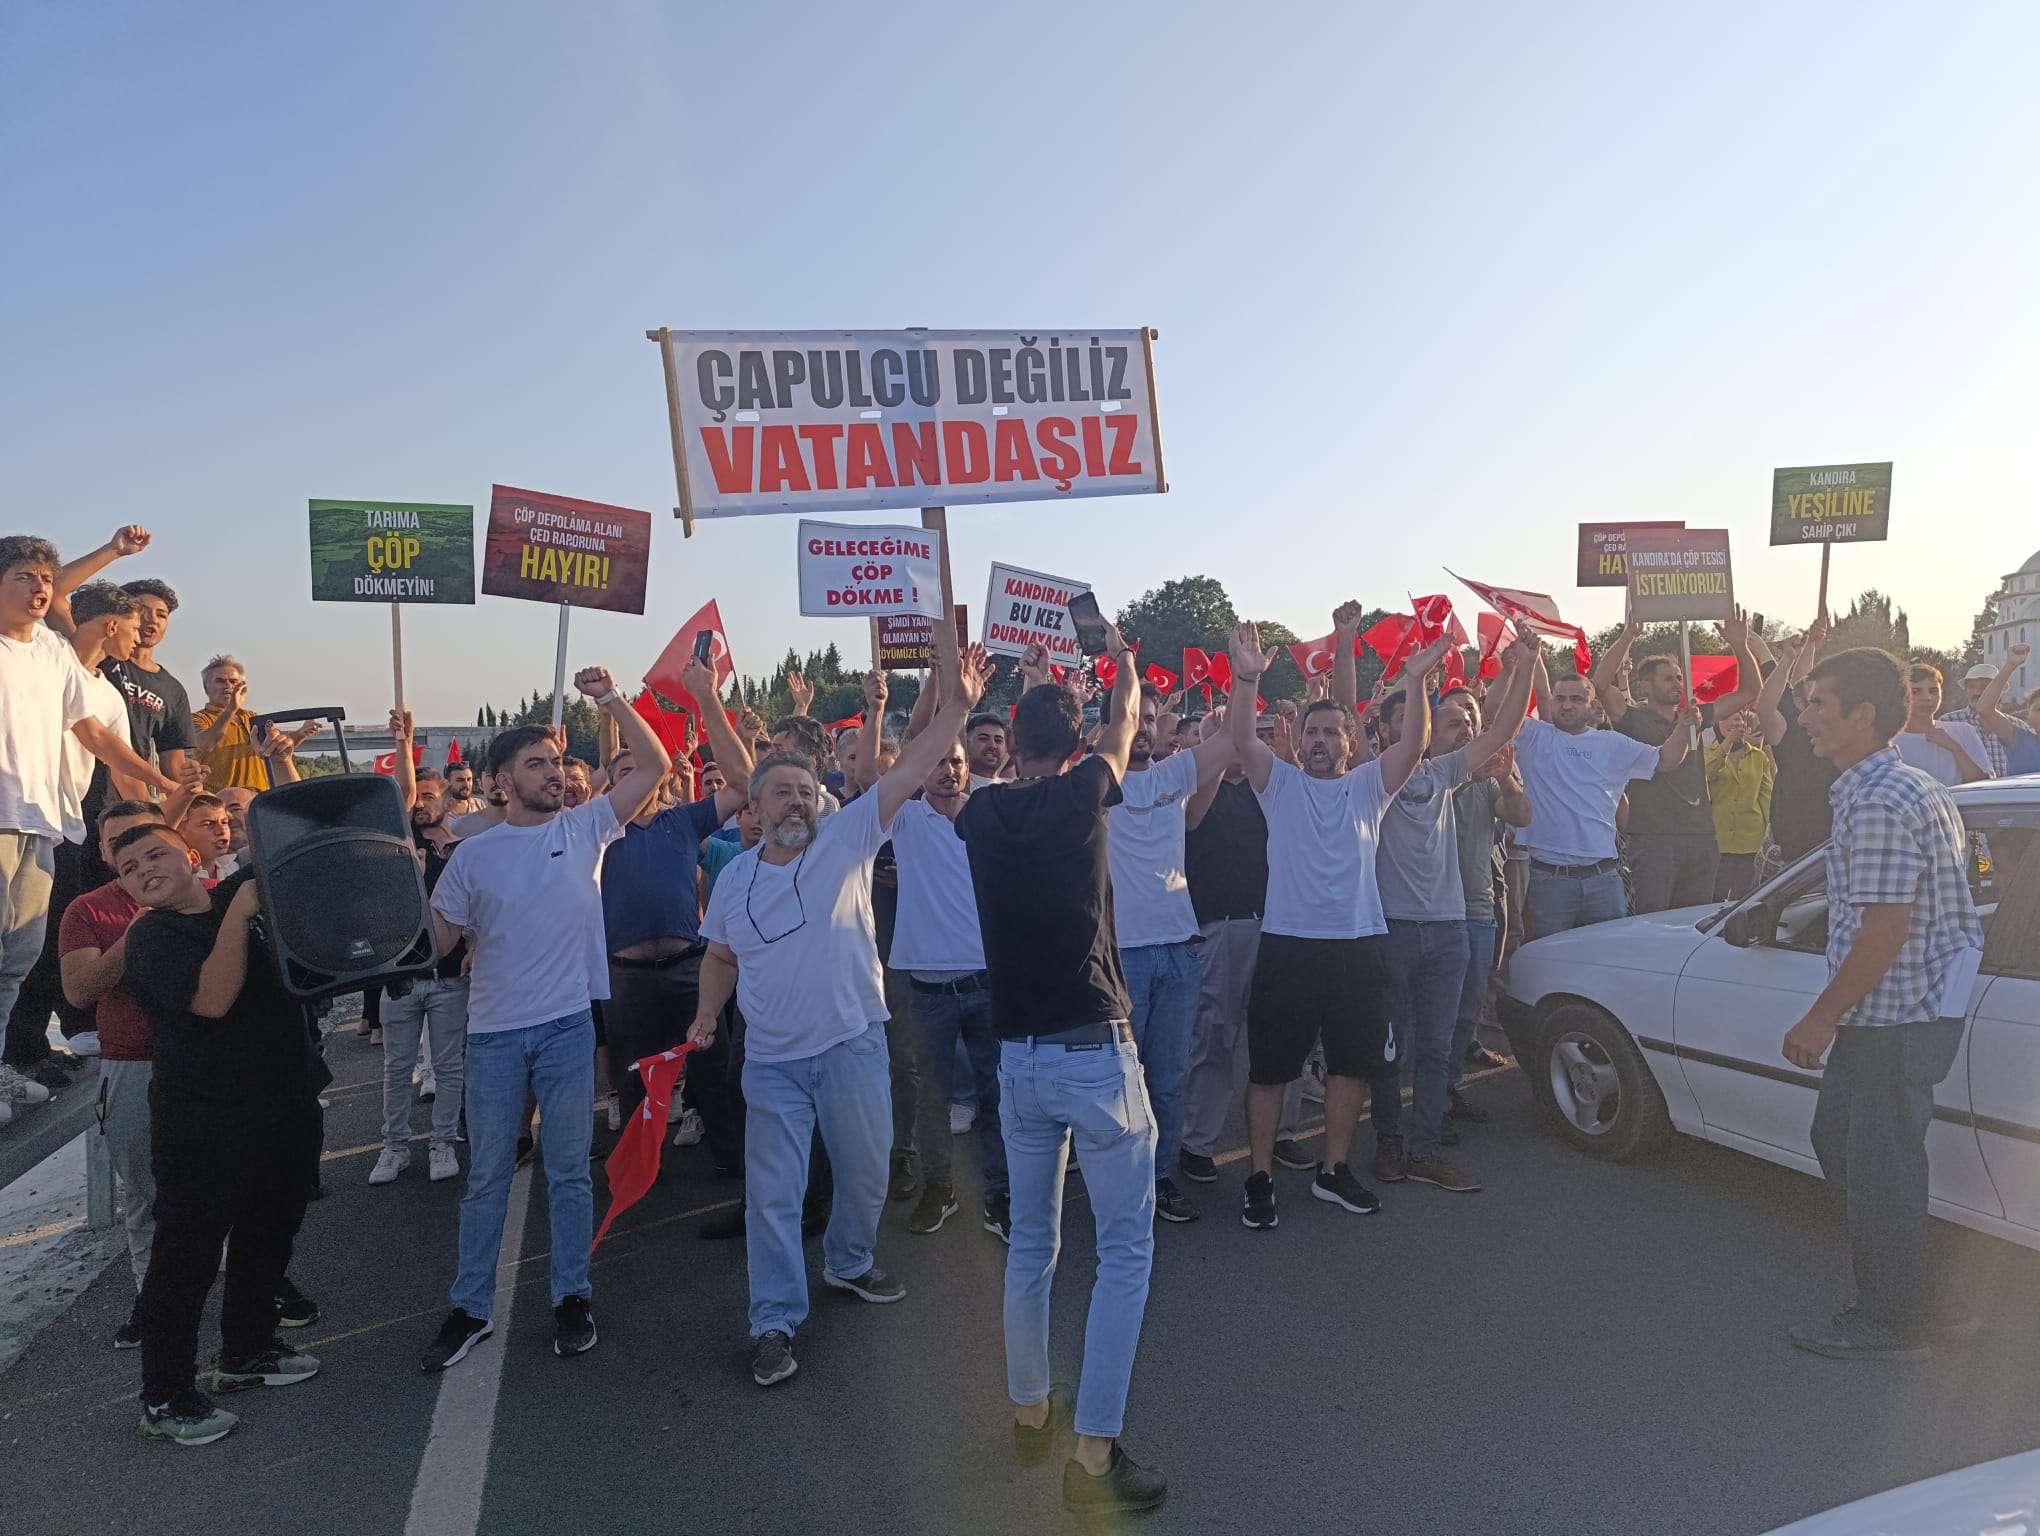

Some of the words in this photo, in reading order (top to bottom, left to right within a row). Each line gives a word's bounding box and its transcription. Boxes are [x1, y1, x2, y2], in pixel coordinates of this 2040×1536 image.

[697, 348, 941, 422] ÇAPULCU
[953, 336, 1131, 405] DEĞİLİZ
[700, 414, 1142, 494] VATANDAŞIZ
[1810, 470, 1856, 486] KANDIRA
[1788, 486, 1876, 522] YEŞİLİNE
[365, 509, 420, 528] TARIMA
[514, 506, 536, 524] ÇÖP
[537, 512, 592, 534] DEPOLAMA
[593, 522, 623, 538] ALANI
[530, 527, 550, 544] ÇED
[552, 531, 605, 552] RAPORUNA
[1593, 532, 1607, 543] ÇÖP
[1802, 522, 1833, 539] SAHİP
[1835, 523, 1857, 539] ÇIK!
[367, 531, 420, 573] ÇÖP
[1604, 543, 1617, 553] ÇED
[1632, 551, 1682, 567] KANDIRA'DA
[1683, 549, 1699, 568] ÇÖP
[1701, 549, 1726, 566] TESİSİ
[520, 544, 610, 590] HAYIR!
[851, 560, 893, 585] ÇÖP
[354, 574, 434, 596] DÖKMEYİN!
[1635, 570, 1727, 596] İSTEMİYORUZ!
[827, 585, 904, 606] DÖKME
[887, 616, 910, 630] ŞİMDİ
[1009, 602, 1032, 624] BU
[1034, 607, 1064, 631] KEZ
[883, 632, 919, 644] OLMAYAN
[879, 647, 918, 660] ÖYÜMÜZE
